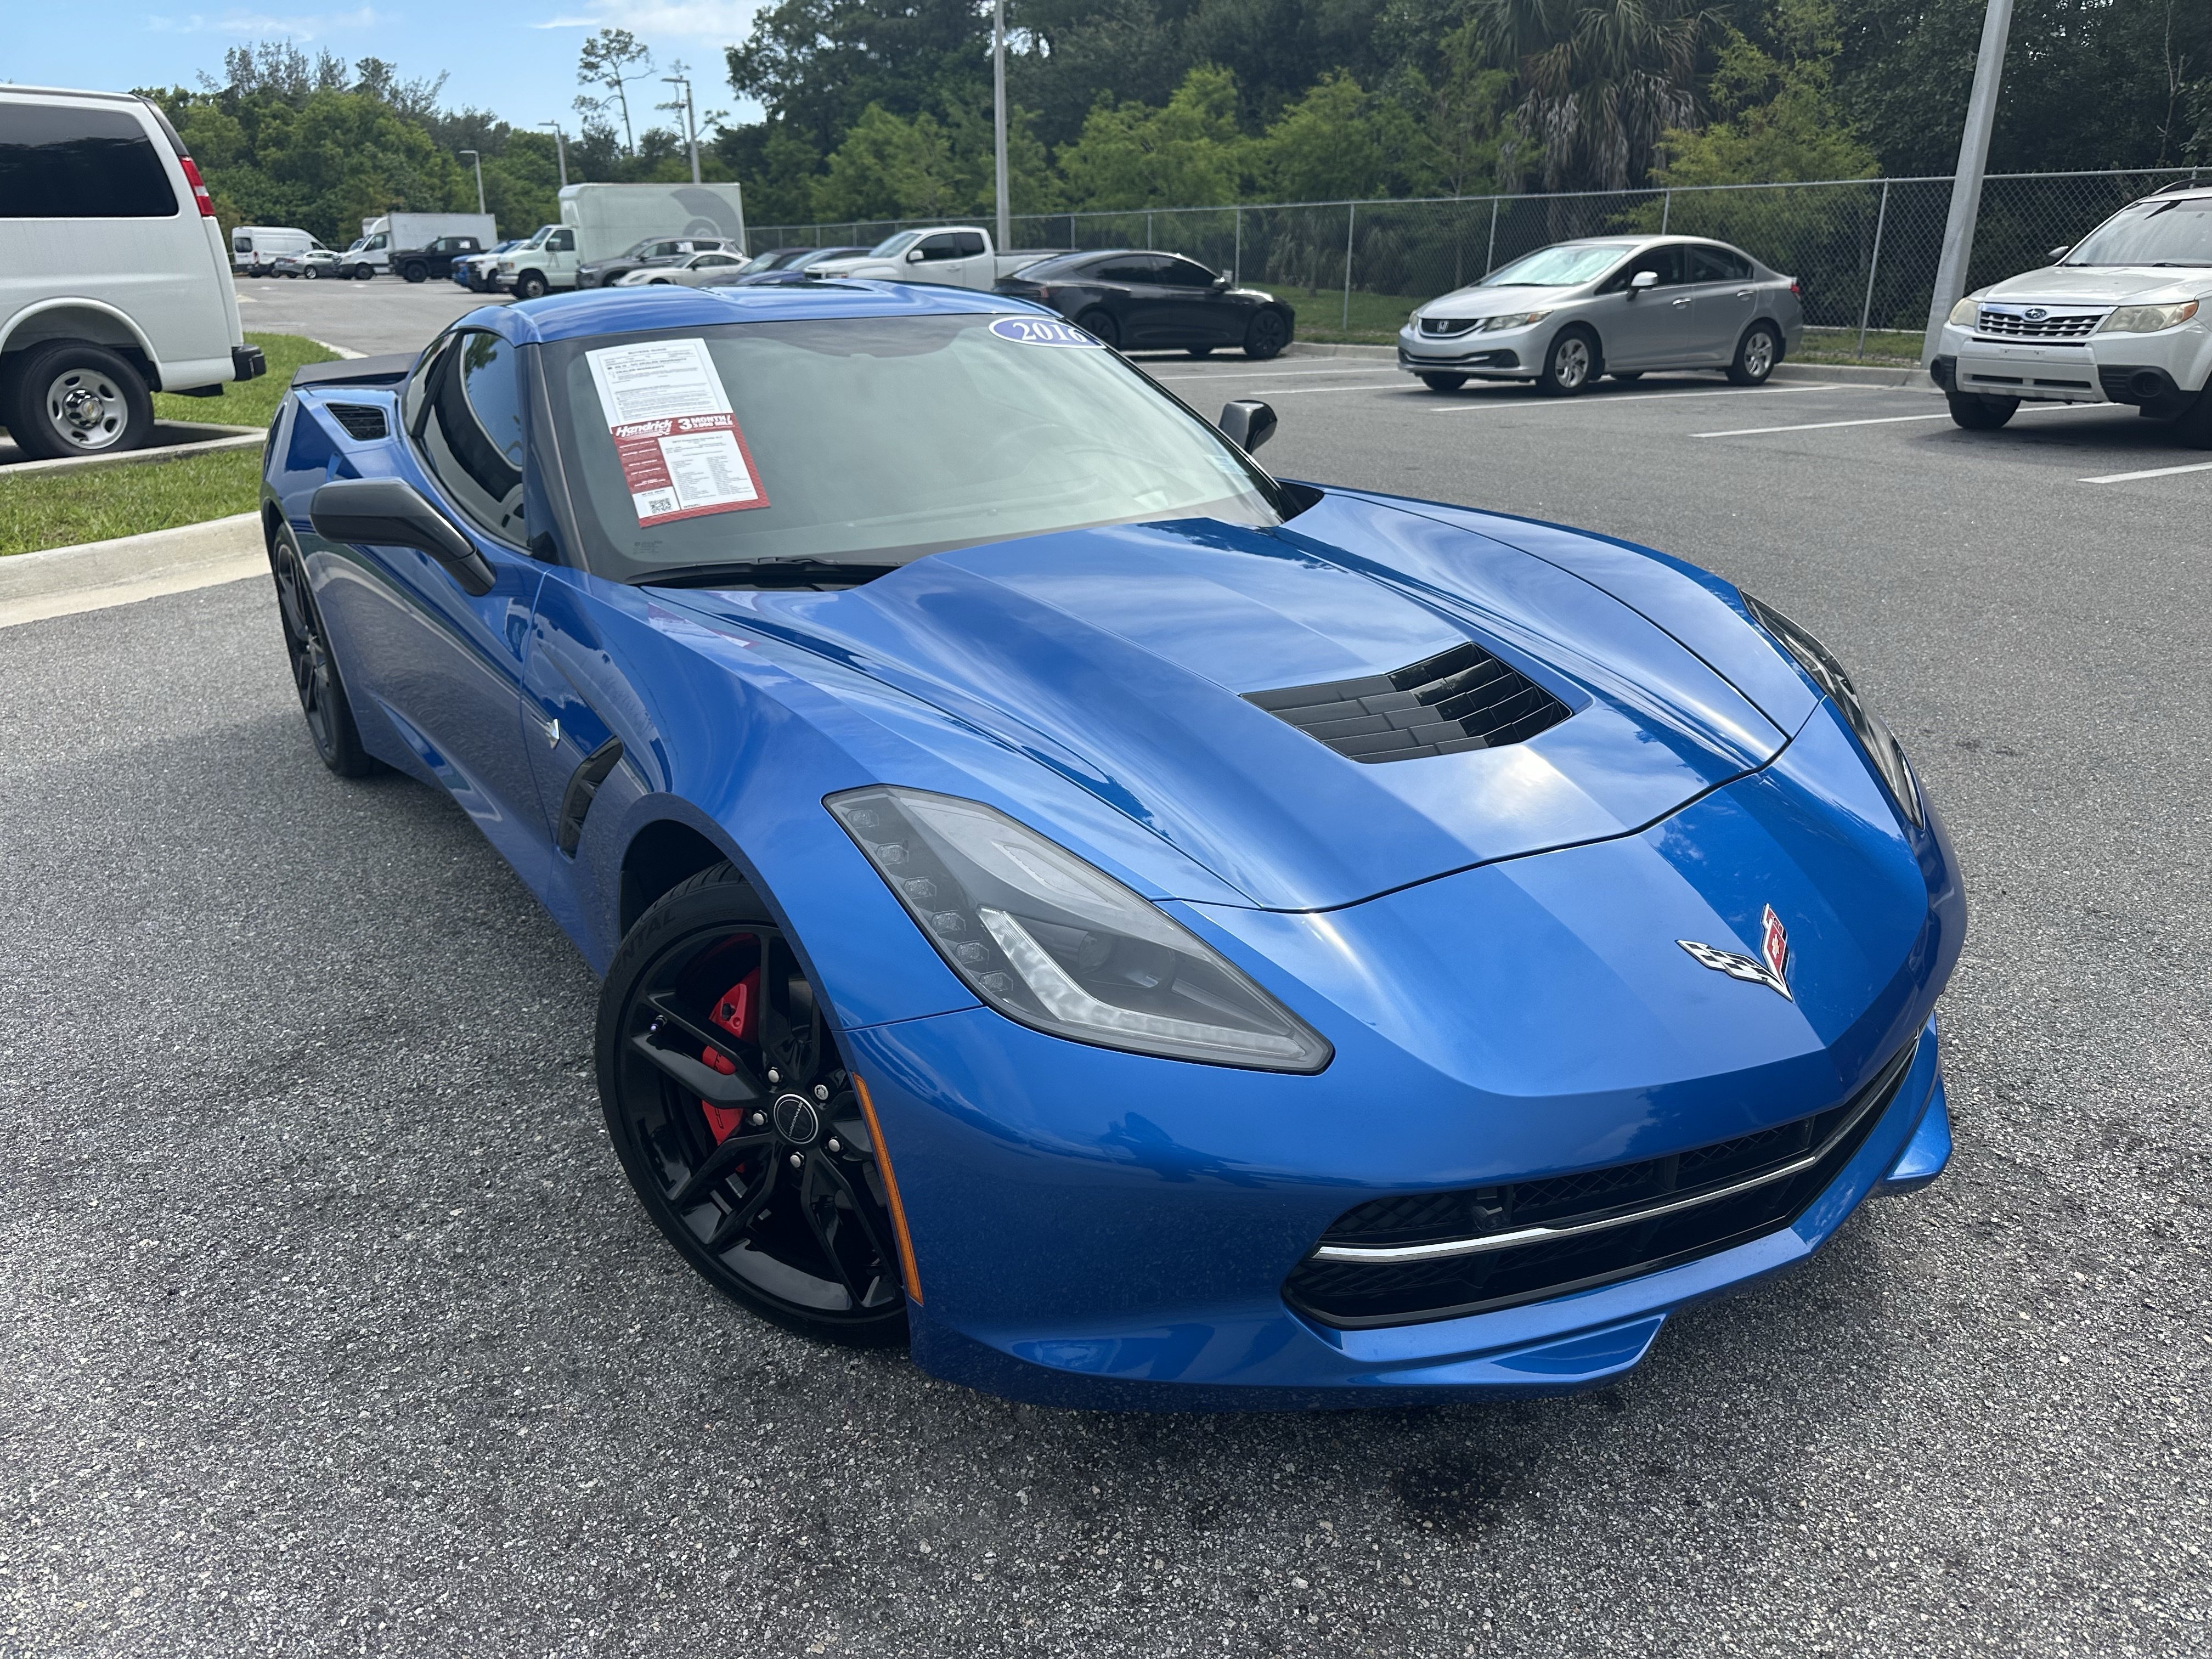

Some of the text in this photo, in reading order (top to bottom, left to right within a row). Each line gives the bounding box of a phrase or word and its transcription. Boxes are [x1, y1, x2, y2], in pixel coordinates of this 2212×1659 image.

[1013, 322, 1087, 342] 2016
[616, 420, 673, 437] Hendrick
[678, 418, 692, 430] 3
